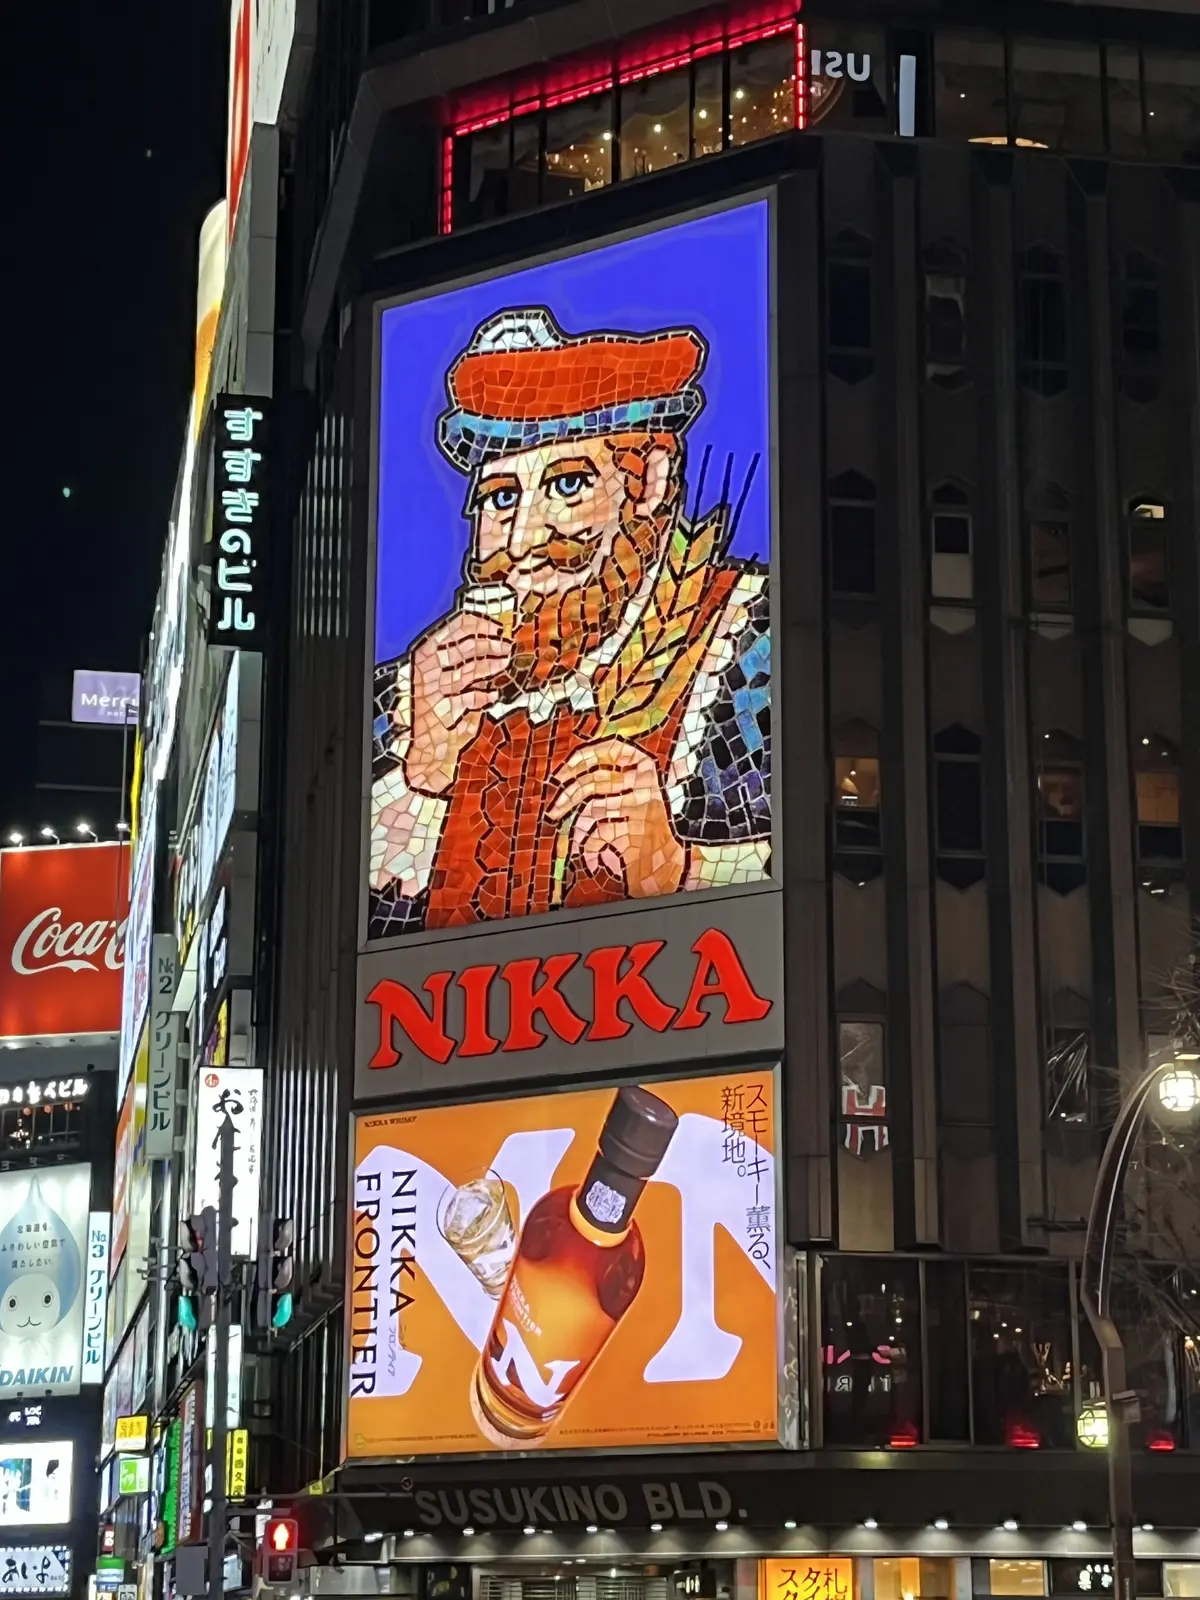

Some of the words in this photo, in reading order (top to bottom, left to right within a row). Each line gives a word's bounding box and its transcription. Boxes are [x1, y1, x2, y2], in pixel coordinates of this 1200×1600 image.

[217, 407, 263, 631] すすきのビル
[365, 928, 773, 1069] NIKKA
[350, 1171, 382, 1399] FRONTIER
[389, 1168, 418, 1318] NIKKA
[0, 1365, 74, 1387] DAIKIN
[415, 1485, 628, 1526] SUSUKINO
[642, 1481, 748, 1520] BLD.
